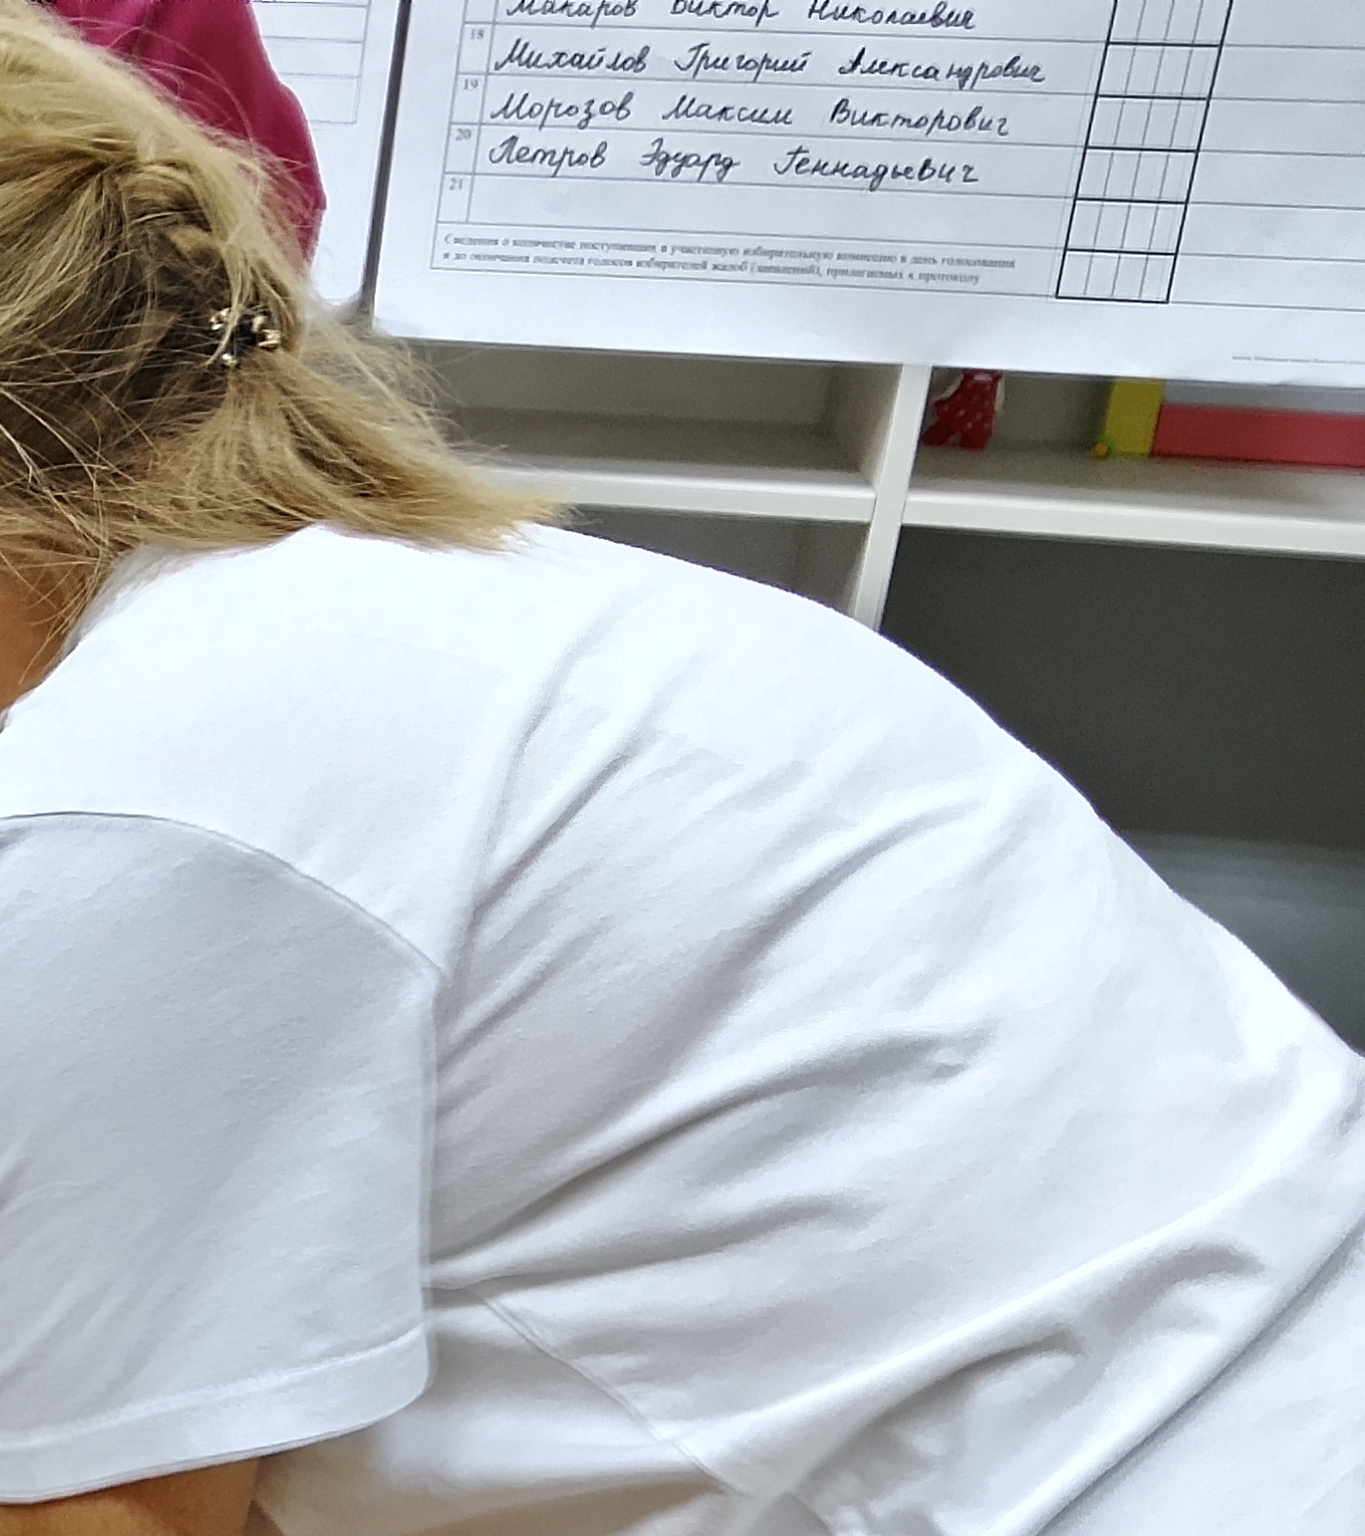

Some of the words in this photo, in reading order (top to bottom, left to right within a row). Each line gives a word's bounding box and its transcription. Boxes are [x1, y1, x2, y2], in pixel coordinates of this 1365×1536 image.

[470, 29, 485, 40] 18
[494, 38, 651, 73] Михайлов
[674, 42, 813, 83] Григорий
[838, 46, 1046, 90] Александрович
[463, 79, 479, 91] 19
[490, 91, 635, 131] Морозов
[662, 94, 794, 125] Максим
[829, 97, 1010, 137] Викторович
[455, 129, 472, 141] 20
[489, 134, 608, 178] Петров
[640, 137, 741, 183] Эдуард
[774, 145, 980, 193] Геннадьевич
[449, 178, 464, 190] 21
